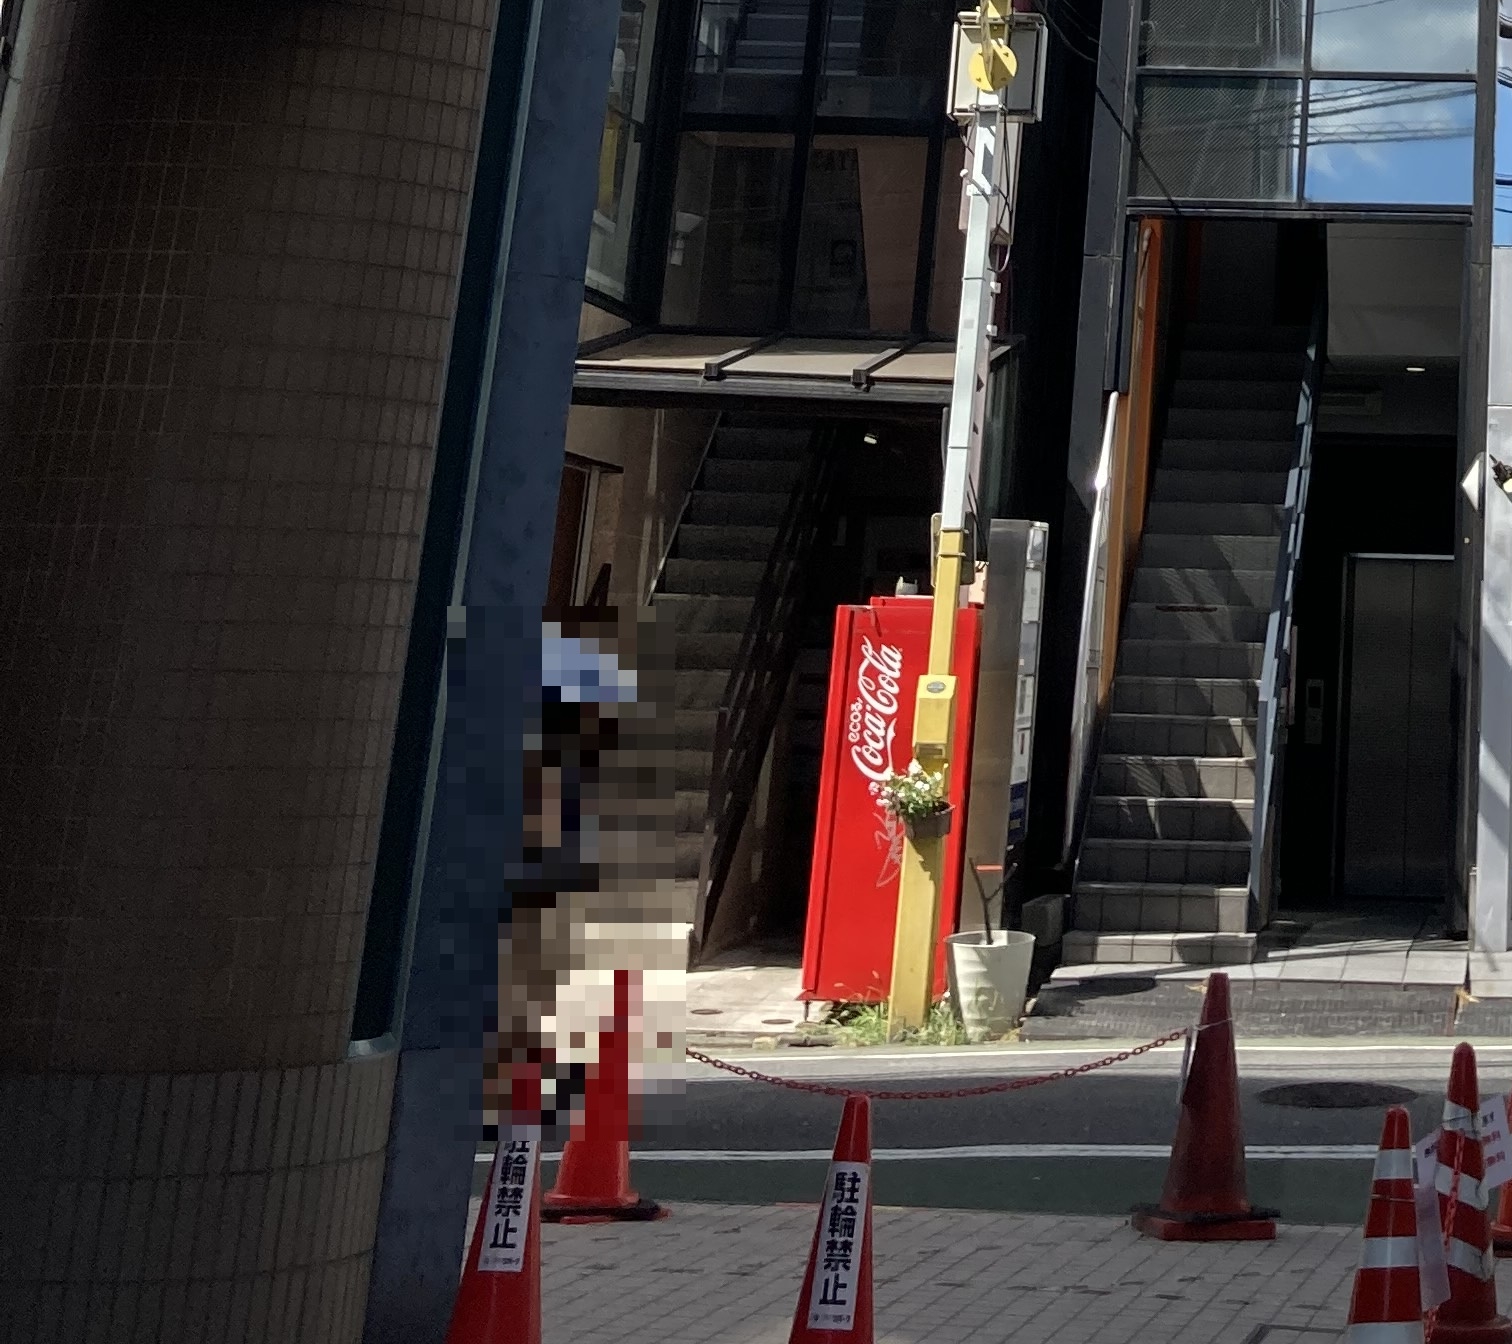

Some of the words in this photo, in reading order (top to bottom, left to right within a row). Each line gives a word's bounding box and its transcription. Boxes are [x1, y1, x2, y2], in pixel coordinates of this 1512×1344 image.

[851, 634, 903, 783] Coca-Cola
[818, 1171, 861, 1306] 駐輪禁止
